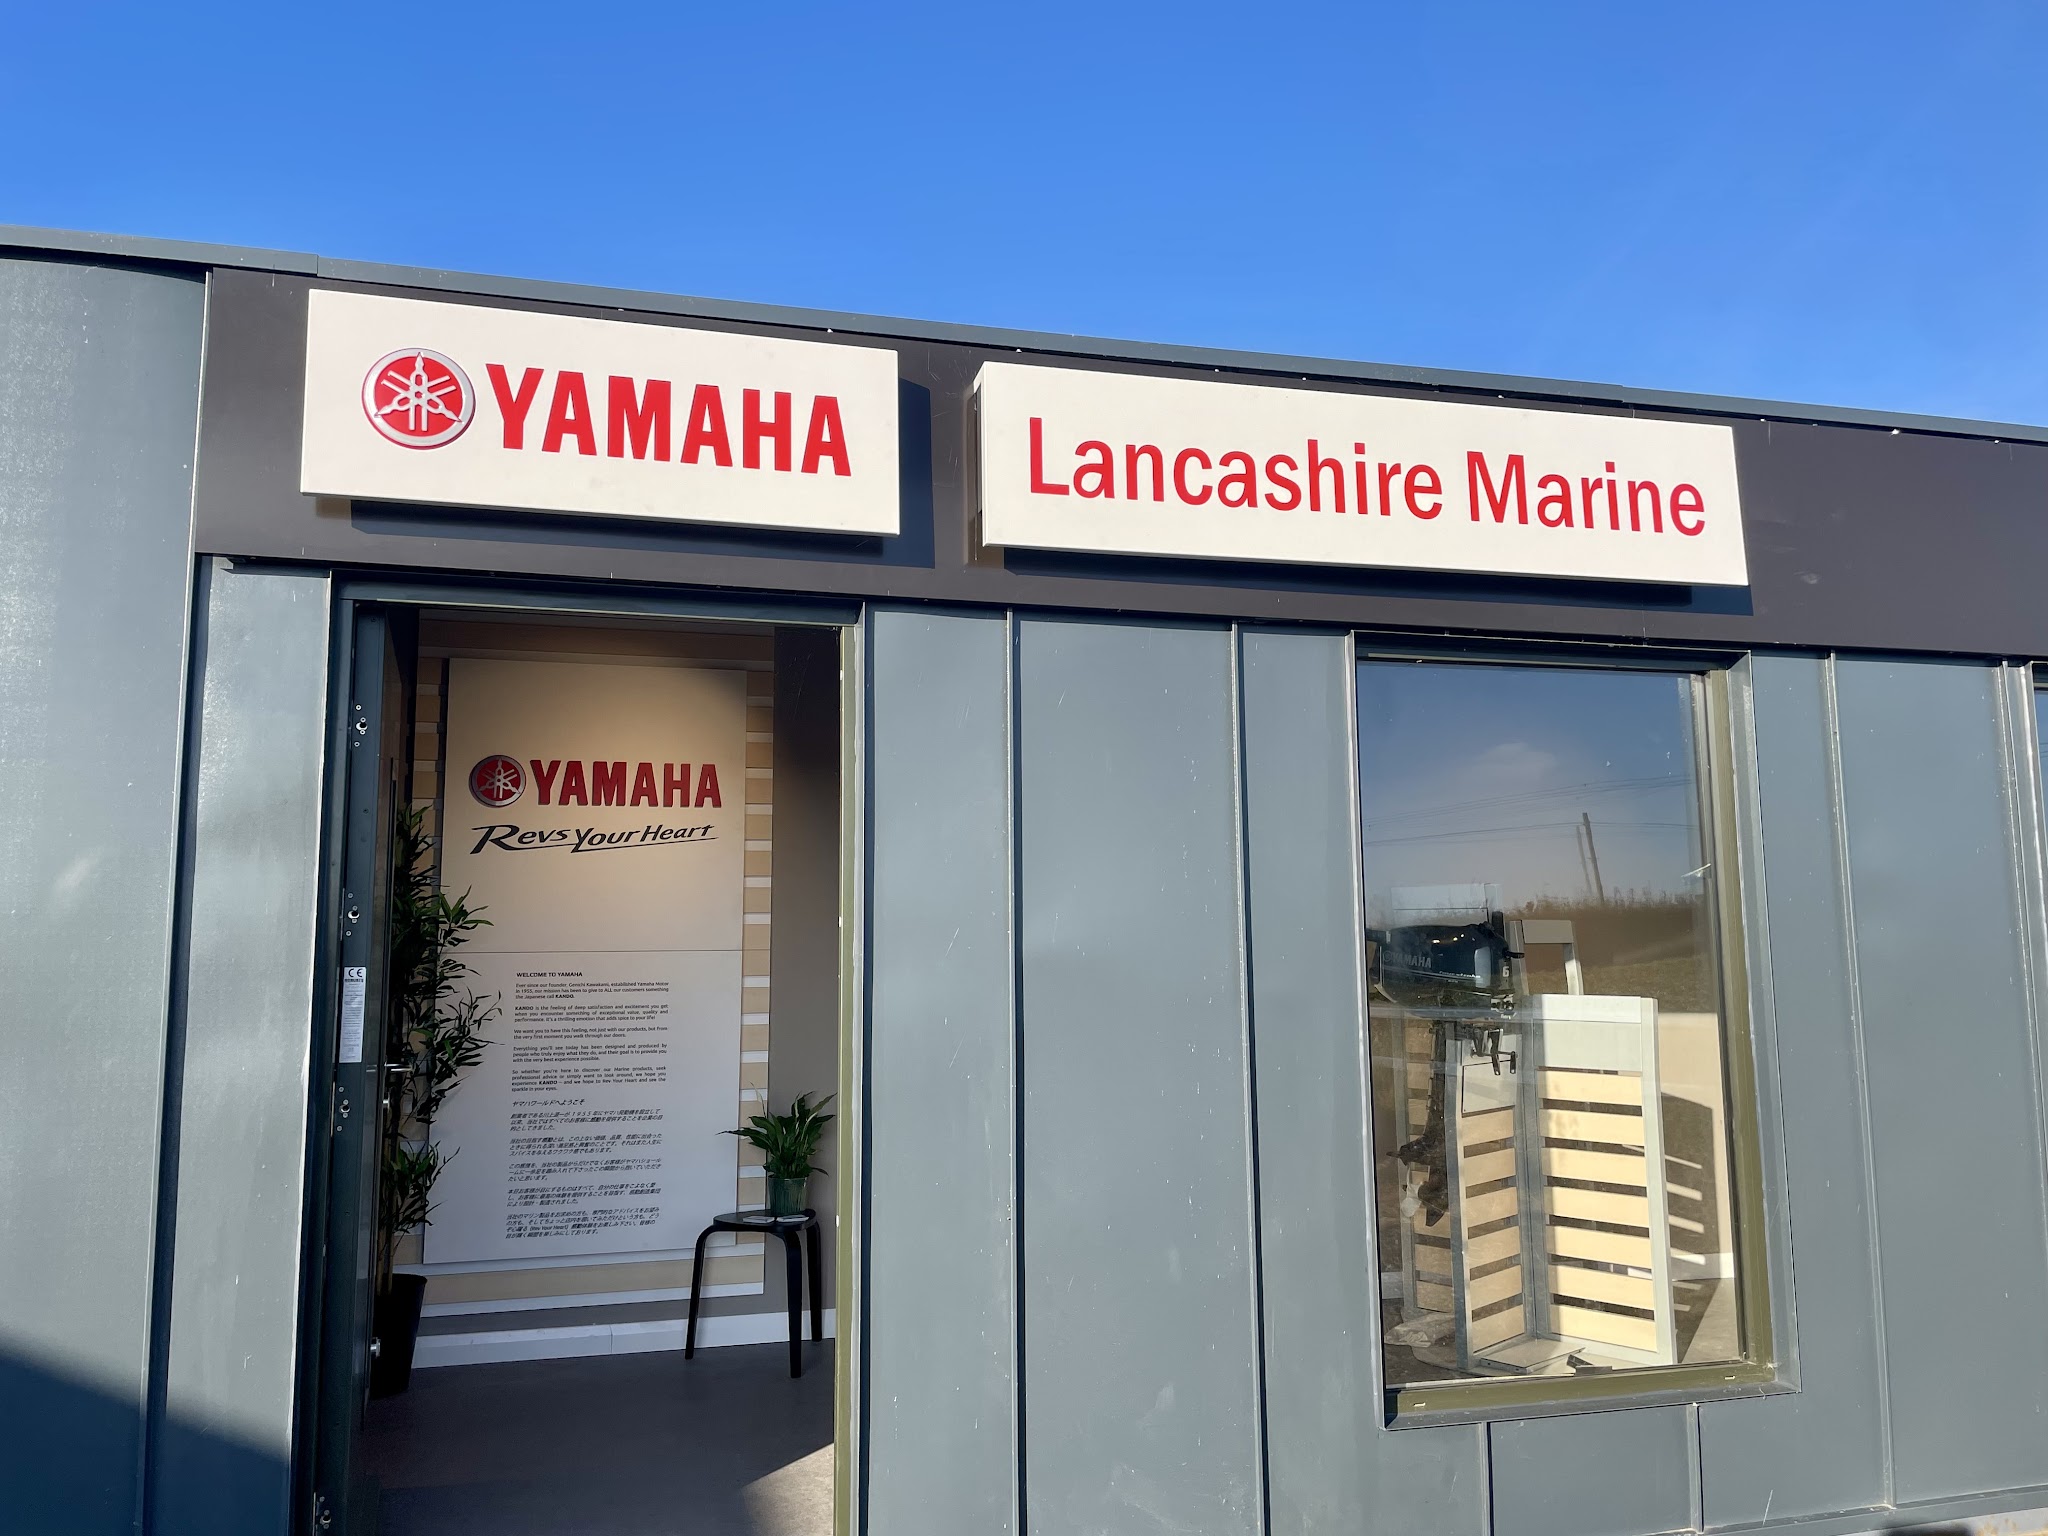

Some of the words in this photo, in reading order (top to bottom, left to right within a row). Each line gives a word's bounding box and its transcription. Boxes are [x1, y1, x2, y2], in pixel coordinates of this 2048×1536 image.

[486, 363, 851, 476] YAMAHA
[1028, 417, 1443, 520] Lancashire
[1467, 450, 1706, 536] Marine
[530, 760, 722, 808] YAMAHA
[470, 824, 571, 854] Revs
[570, 827, 640, 853] Your
[640, 824, 715, 843] Heart
[348, 968, 363, 978] CE
[1392, 952, 1432, 968] YAMAHA
[1502, 966, 1510, 978] 6
